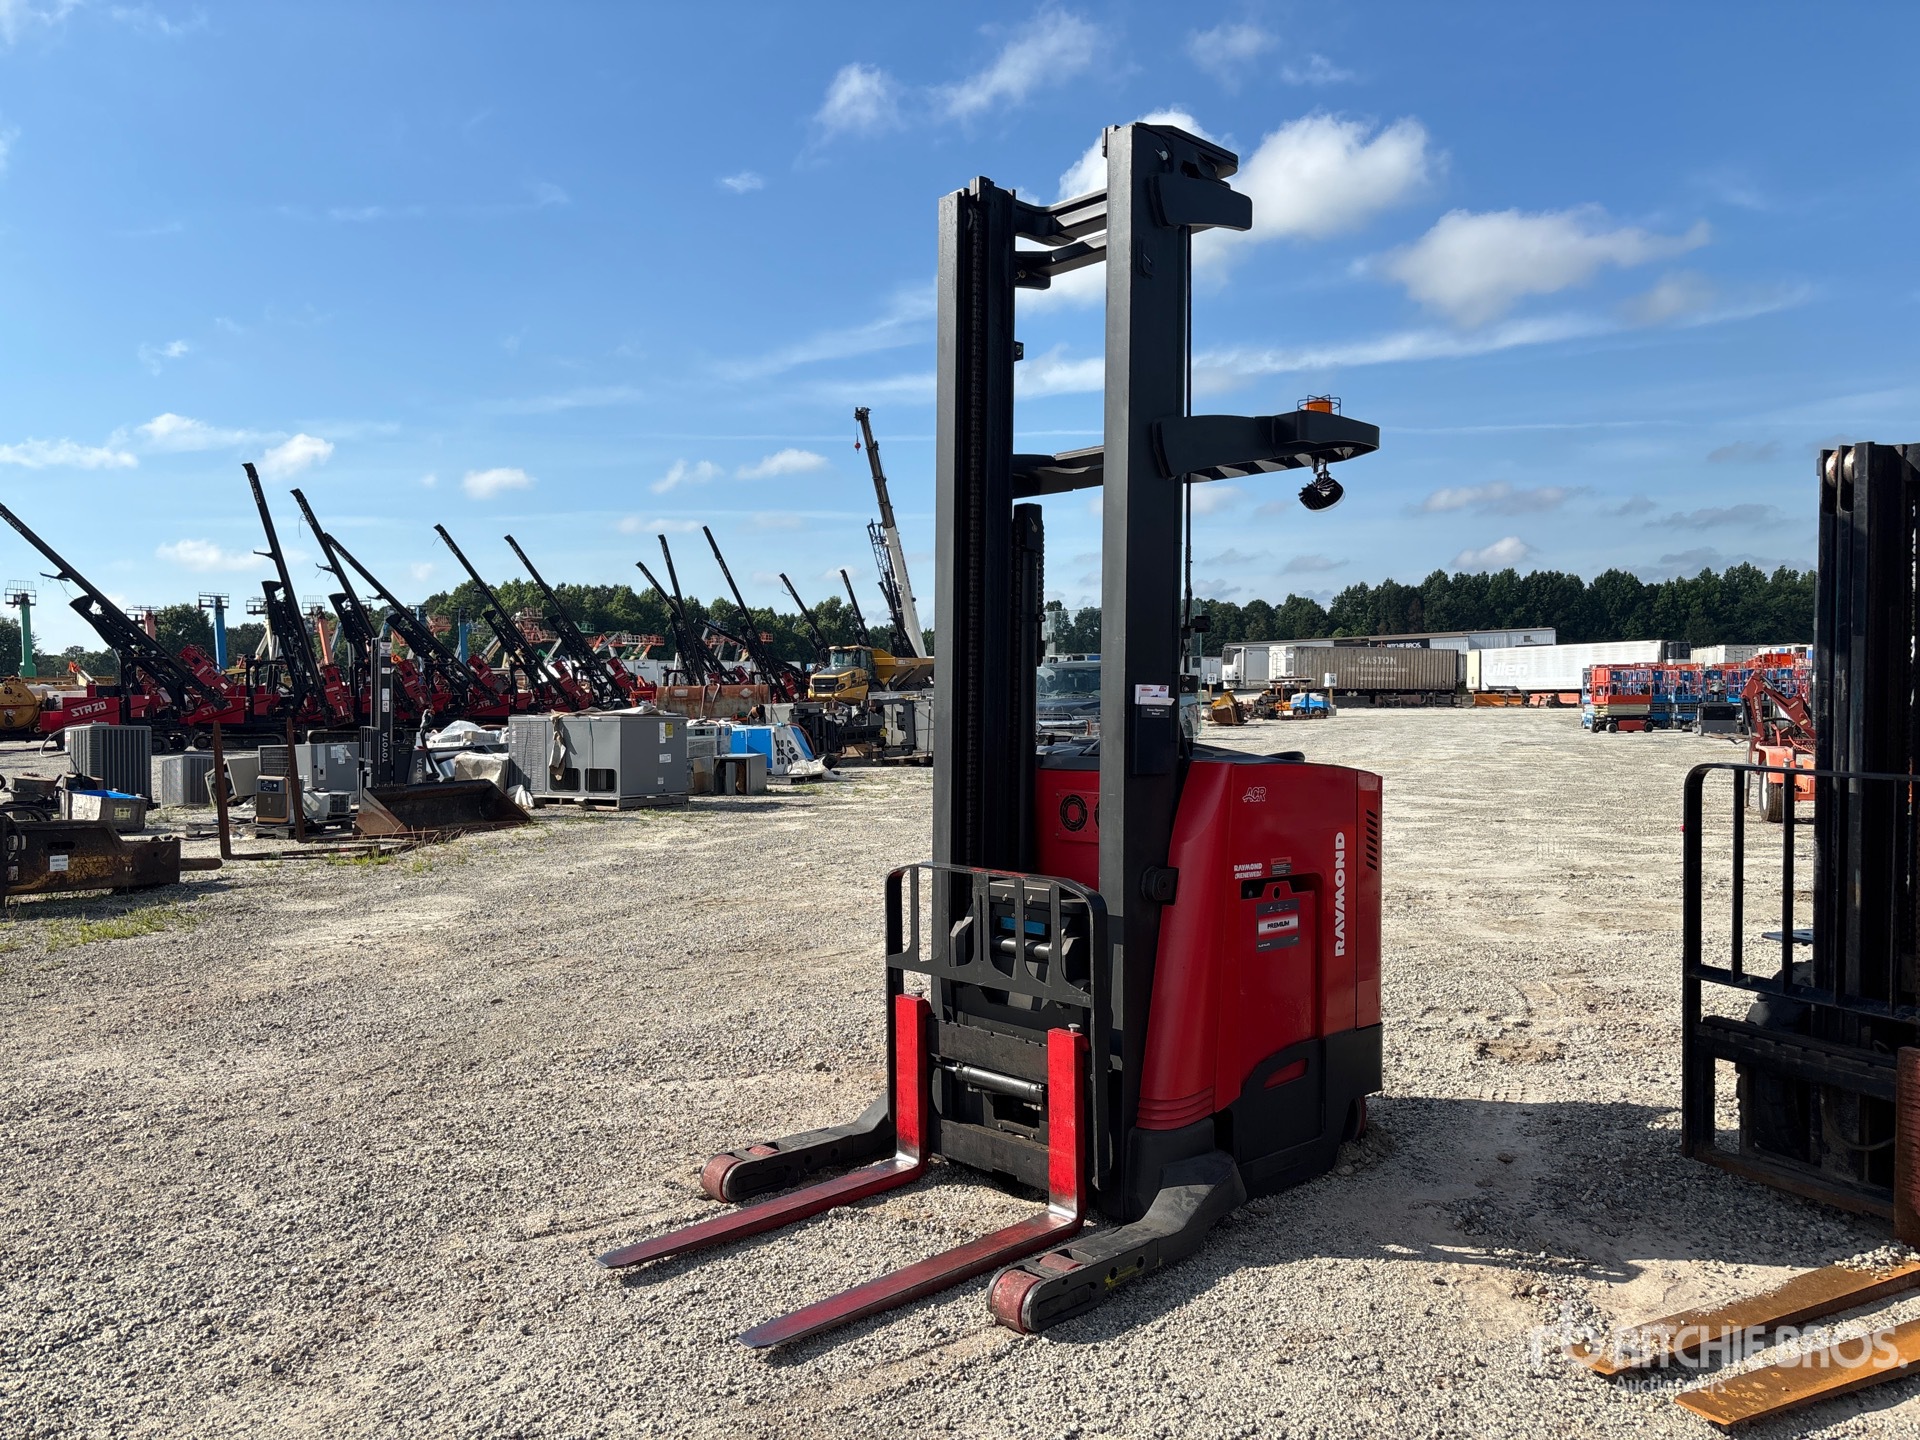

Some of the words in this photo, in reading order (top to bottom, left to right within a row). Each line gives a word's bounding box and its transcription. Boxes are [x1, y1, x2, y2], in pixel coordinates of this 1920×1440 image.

[1358, 656, 1397, 665] GASTON
[381, 731, 389, 763] TOYOTA
[1242, 786, 1266, 802] ACR
[1233, 863, 1263, 872] RAYMOND
[1335, 831, 1346, 957] RAYMOND
[1267, 920, 1290, 929] PREMIUM
